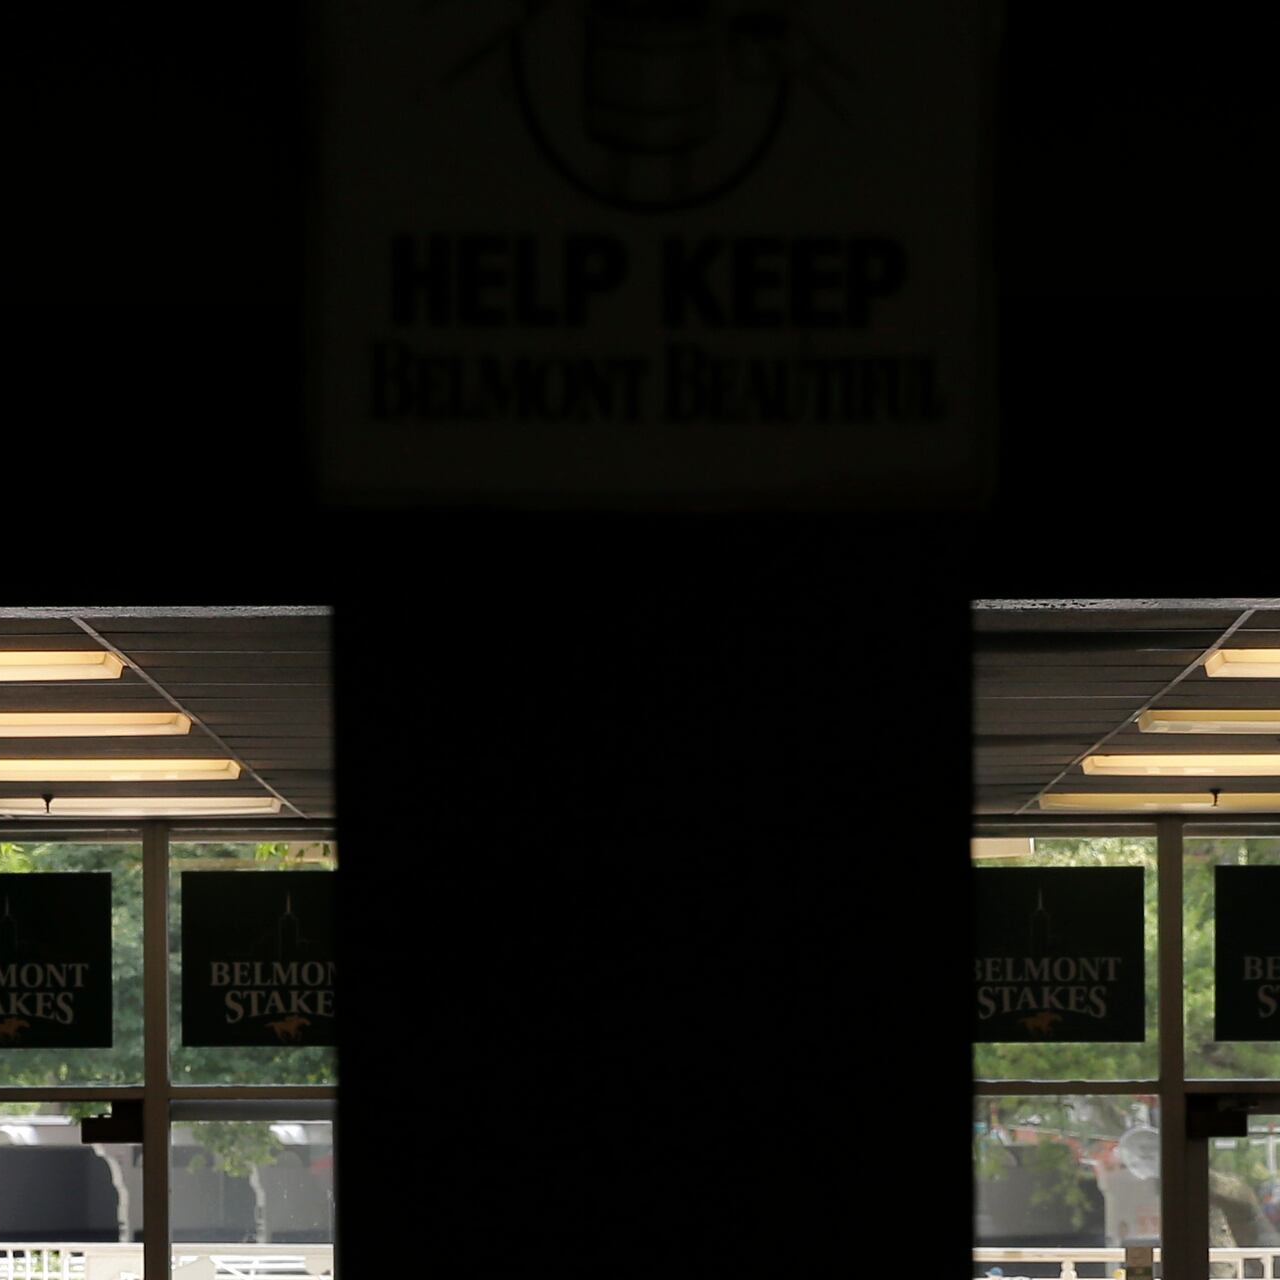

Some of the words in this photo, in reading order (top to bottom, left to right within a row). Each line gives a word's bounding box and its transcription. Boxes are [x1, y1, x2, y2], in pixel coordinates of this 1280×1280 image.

[390, 233, 630, 328] HELP
[661, 235, 908, 329] KEEP
[371, 341, 649, 422] BELMONT
[665, 342, 948, 425] BEAUTIFUL
[210, 960, 338, 987] BELMON
[224, 989, 336, 1025] STAKE
[976, 985, 1108, 1020] STAKES
